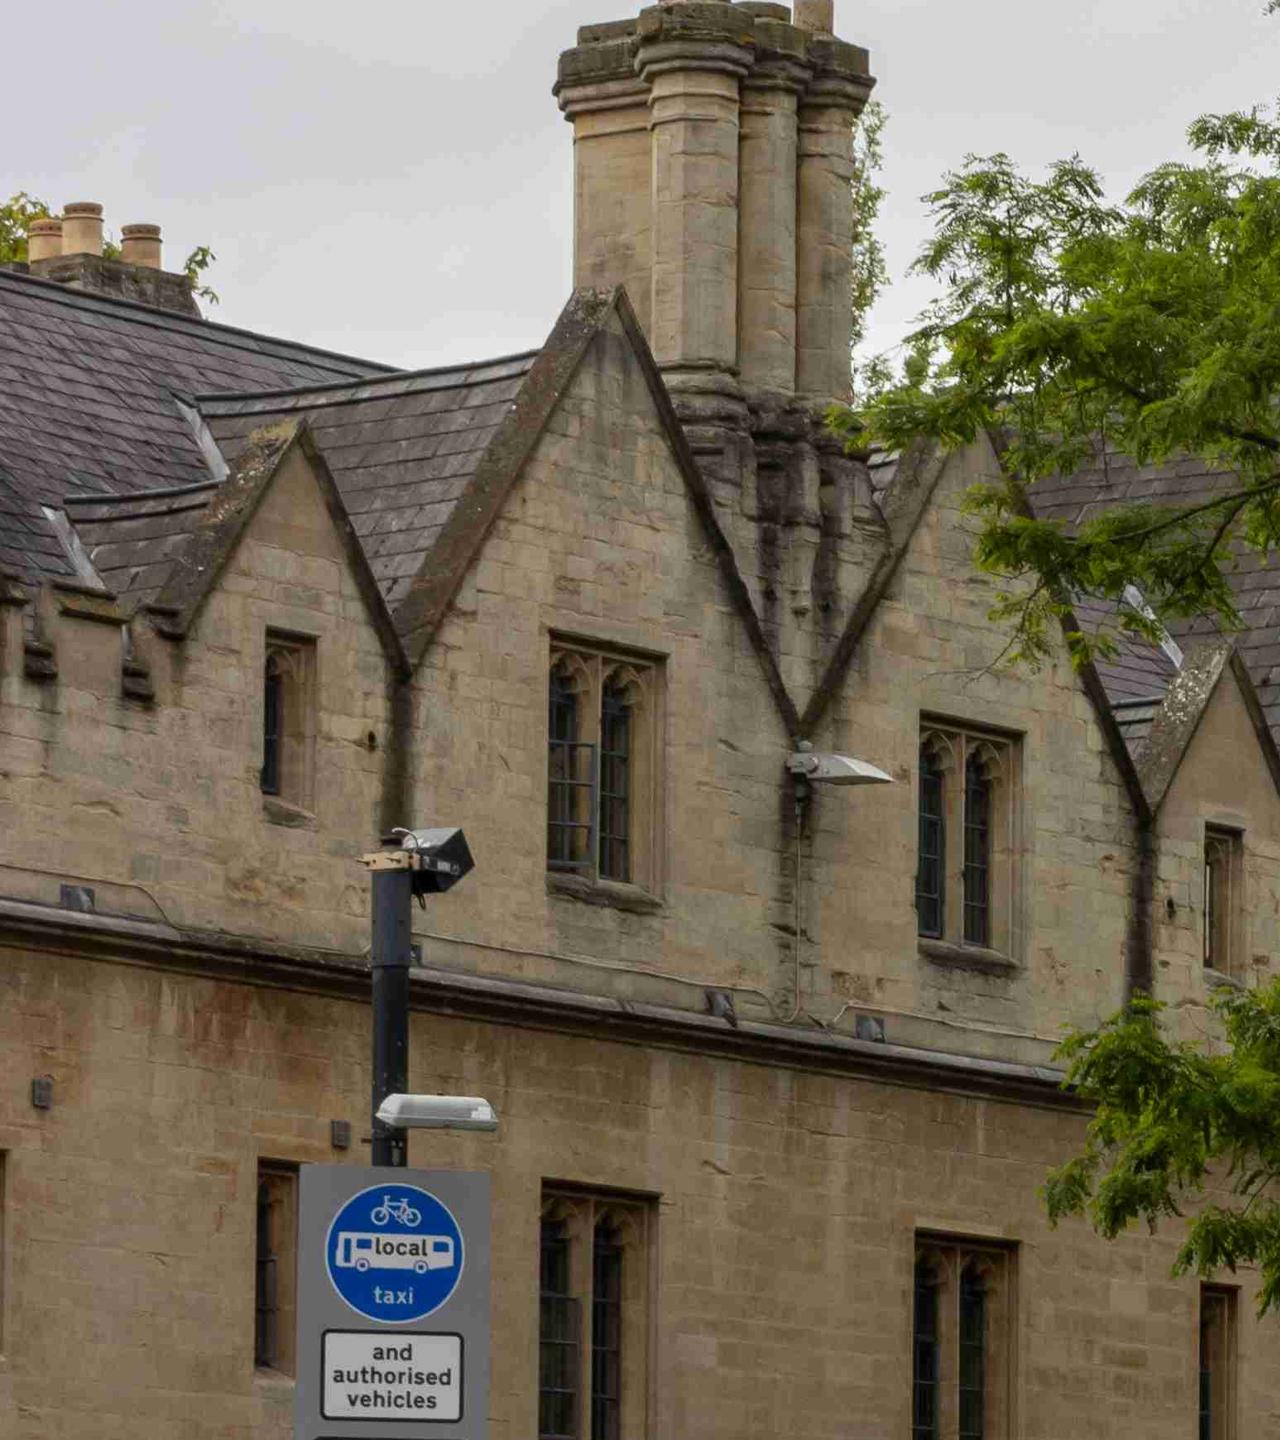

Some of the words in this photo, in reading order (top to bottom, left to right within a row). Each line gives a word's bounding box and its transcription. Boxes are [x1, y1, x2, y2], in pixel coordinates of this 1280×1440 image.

[375, 1236, 427, 1256] local
[374, 1286, 414, 1305] taxi
[372, 1344, 413, 1361] and
[333, 1367, 452, 1386] authorised
[347, 1391, 437, 1409] vehicles
